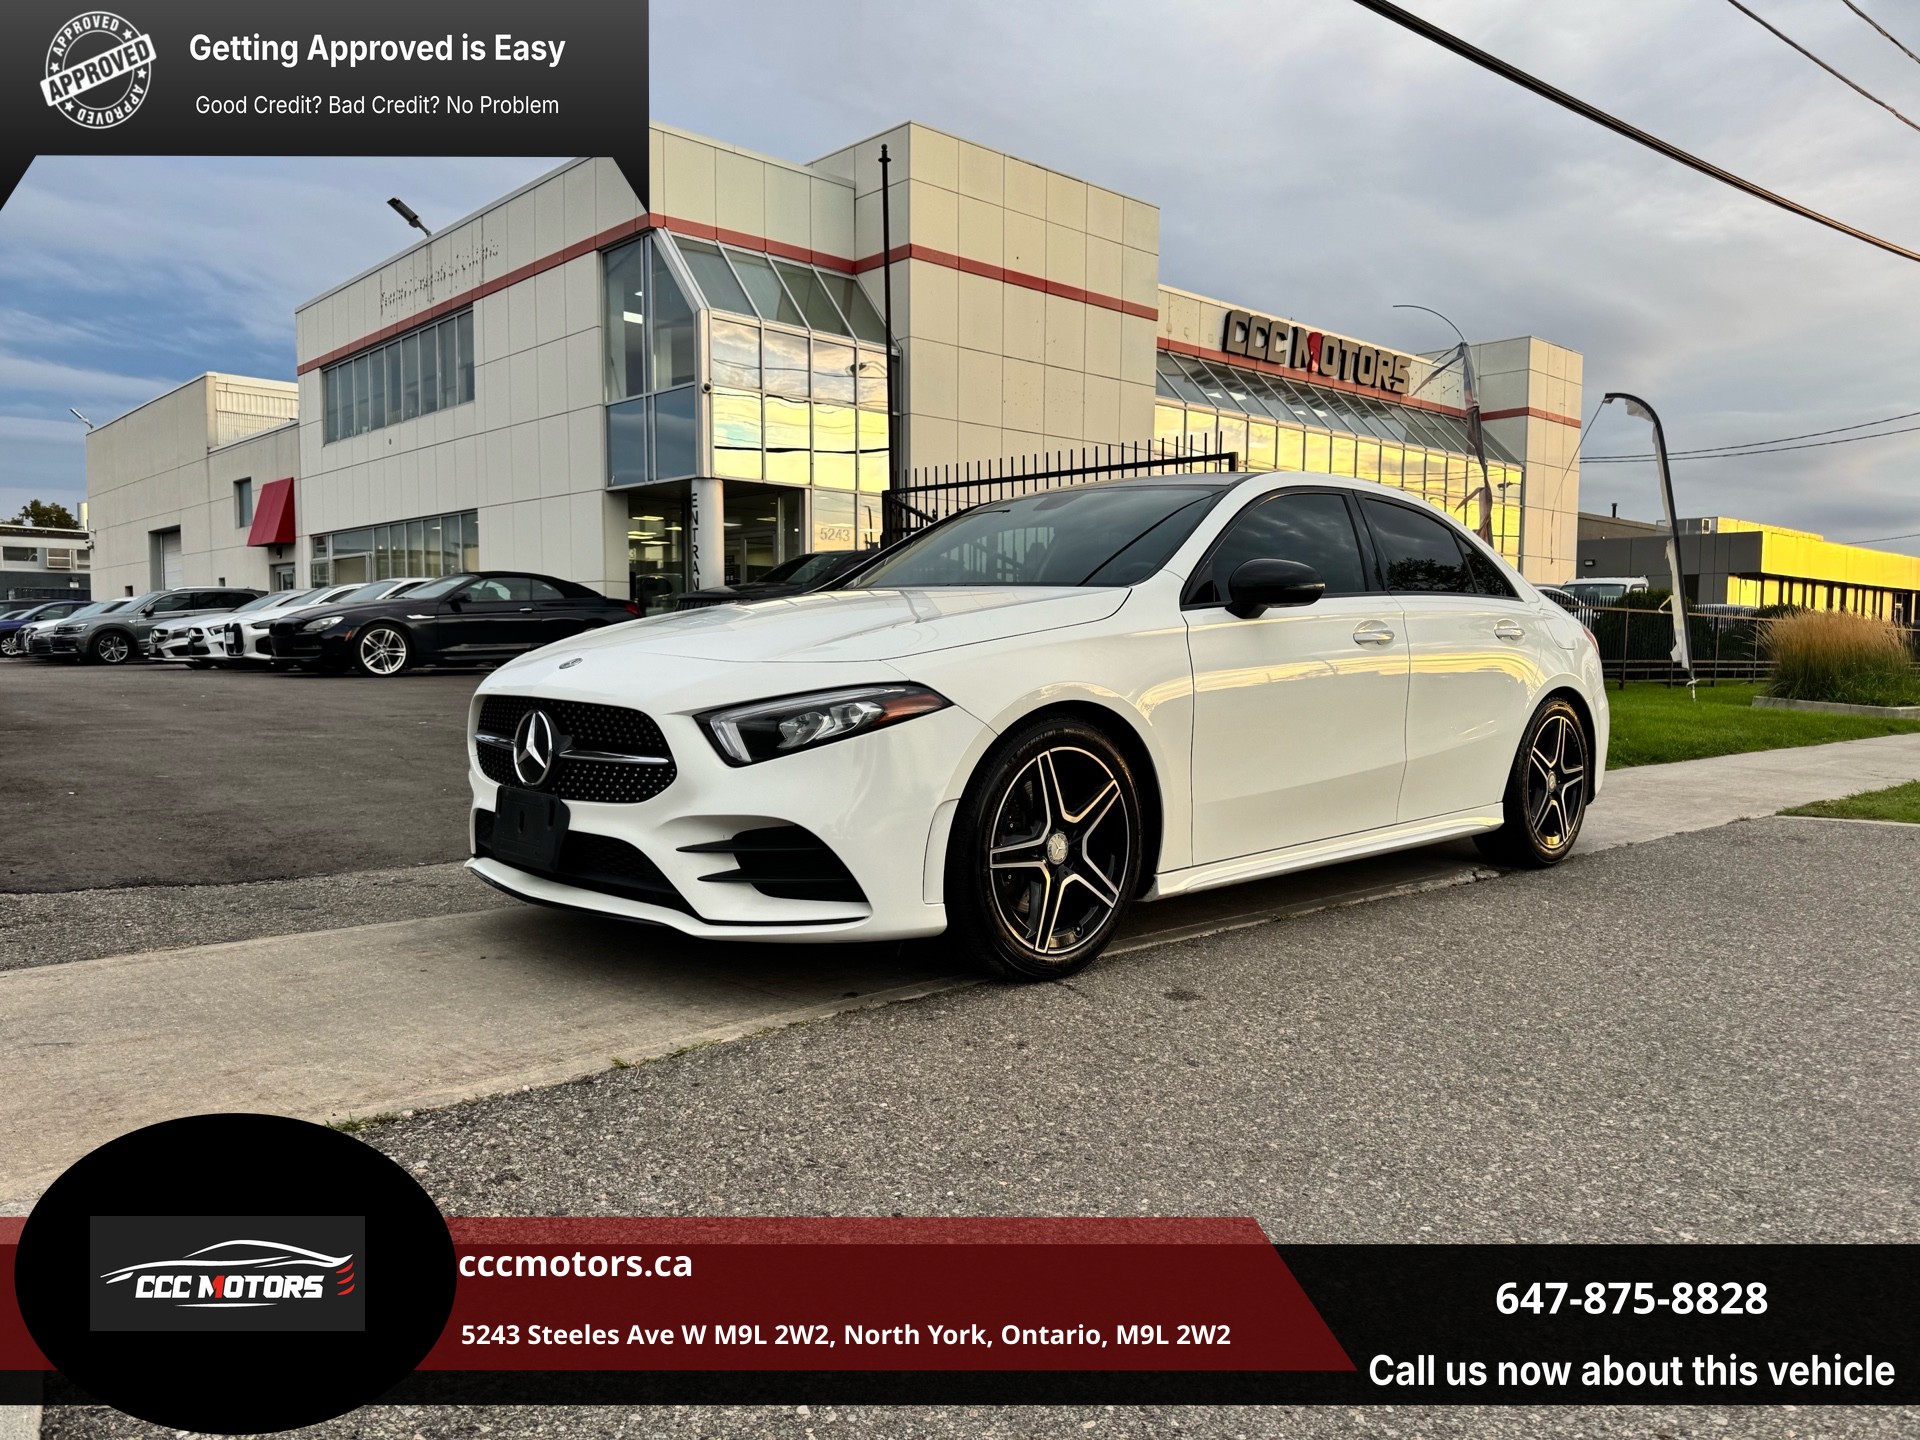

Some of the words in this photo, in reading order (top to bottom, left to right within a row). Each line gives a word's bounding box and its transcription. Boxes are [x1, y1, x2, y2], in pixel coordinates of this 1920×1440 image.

[1222, 309, 1290, 364] CCC
[1290, 326, 1412, 394] MOTORS
[691, 493, 700, 591] ENTRAN
[820, 527, 850, 542] 5243
